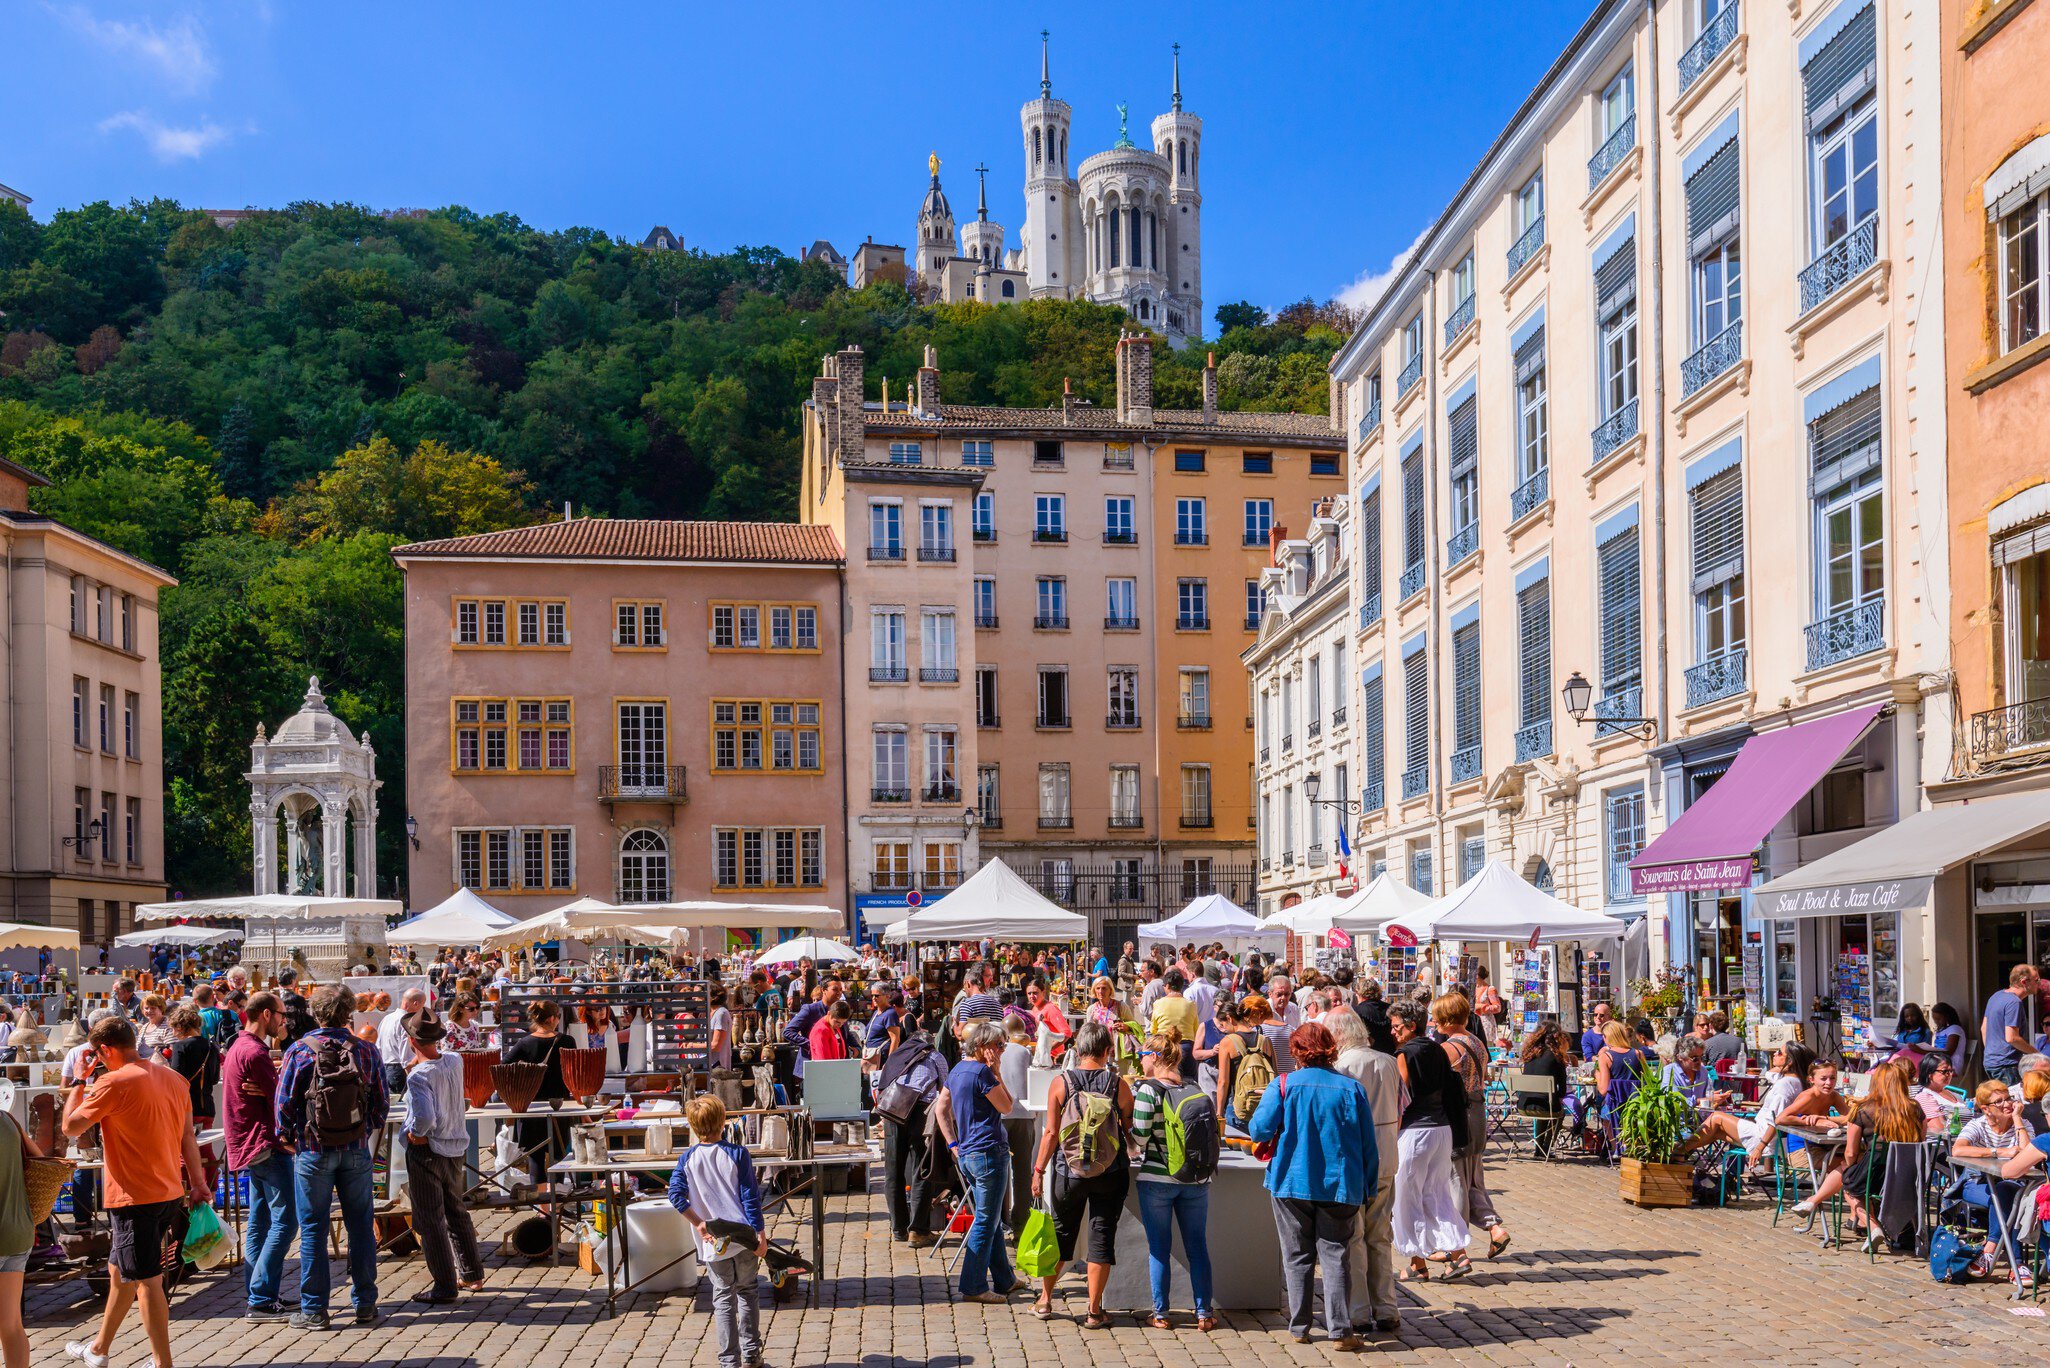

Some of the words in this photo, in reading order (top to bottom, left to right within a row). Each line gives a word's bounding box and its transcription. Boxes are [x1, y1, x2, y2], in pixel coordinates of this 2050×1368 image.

[1639, 868, 1679, 885] Souvenirs
[1681, 865, 1692, 881] de
[1694, 863, 1718, 881] Saint
[1719, 861, 1742, 879] Jean
[1775, 892, 1801, 912] Soul
[1801, 890, 1829, 910] Food
[1830, 889, 1841, 908] &
[1844, 888, 1870, 908] Jazz
[1872, 884, 1901, 911] Café
